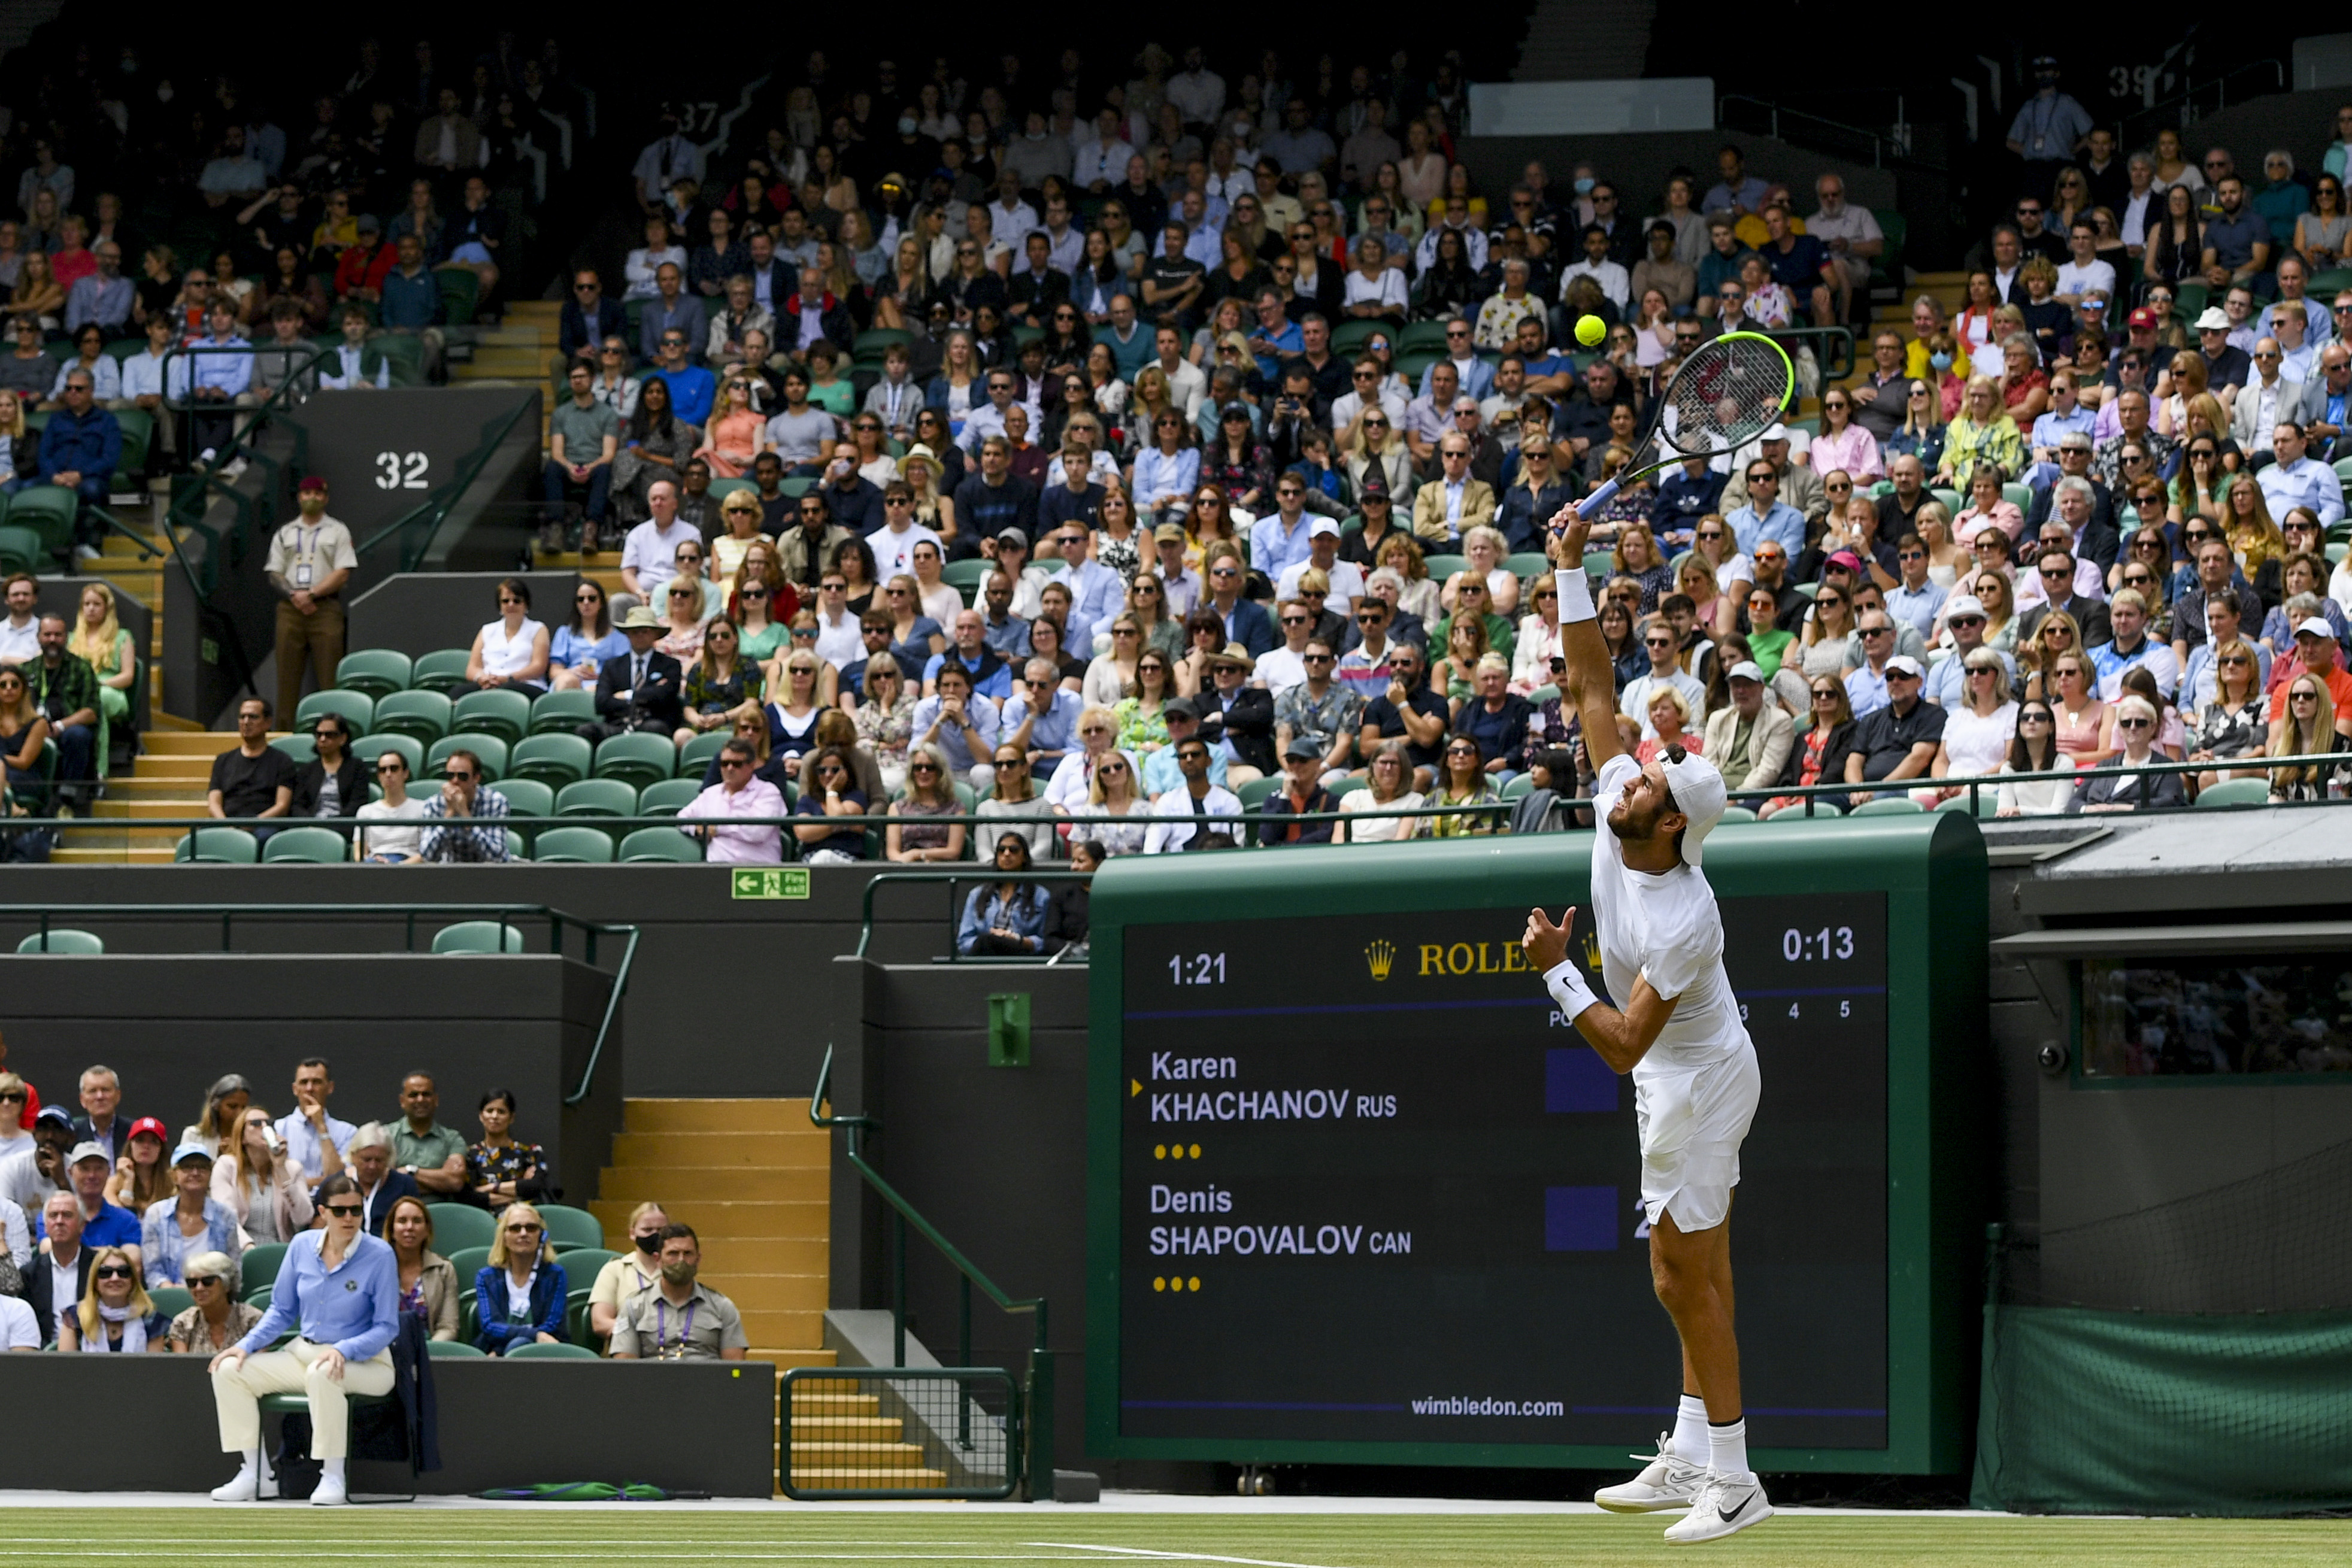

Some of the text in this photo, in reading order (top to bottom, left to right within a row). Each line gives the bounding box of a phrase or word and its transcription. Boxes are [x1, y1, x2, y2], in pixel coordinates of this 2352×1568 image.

[375, 451, 429, 490] 32
[784, 872, 805, 884] Fire
[784, 884, 805, 894] exit
[1419, 940, 1539, 976] ROLE
[1783, 927, 1854, 961] 0:13
[1168, 953, 1226, 985] 1:21
[1739, 1003, 1749, 1021] 3
[1788, 1002, 1799, 1019] 4
[1839, 1000, 1850, 1018] 5
[1152, 1051, 1236, 1080] Karen
[1151, 1089, 1397, 1122] KHACHANOV RUS
[1151, 1184, 1232, 1213] Denis
[1150, 1225, 1411, 1255] SHAPOVALOV CAN
[1411, 1396, 1564, 1417] wimbledon.com
